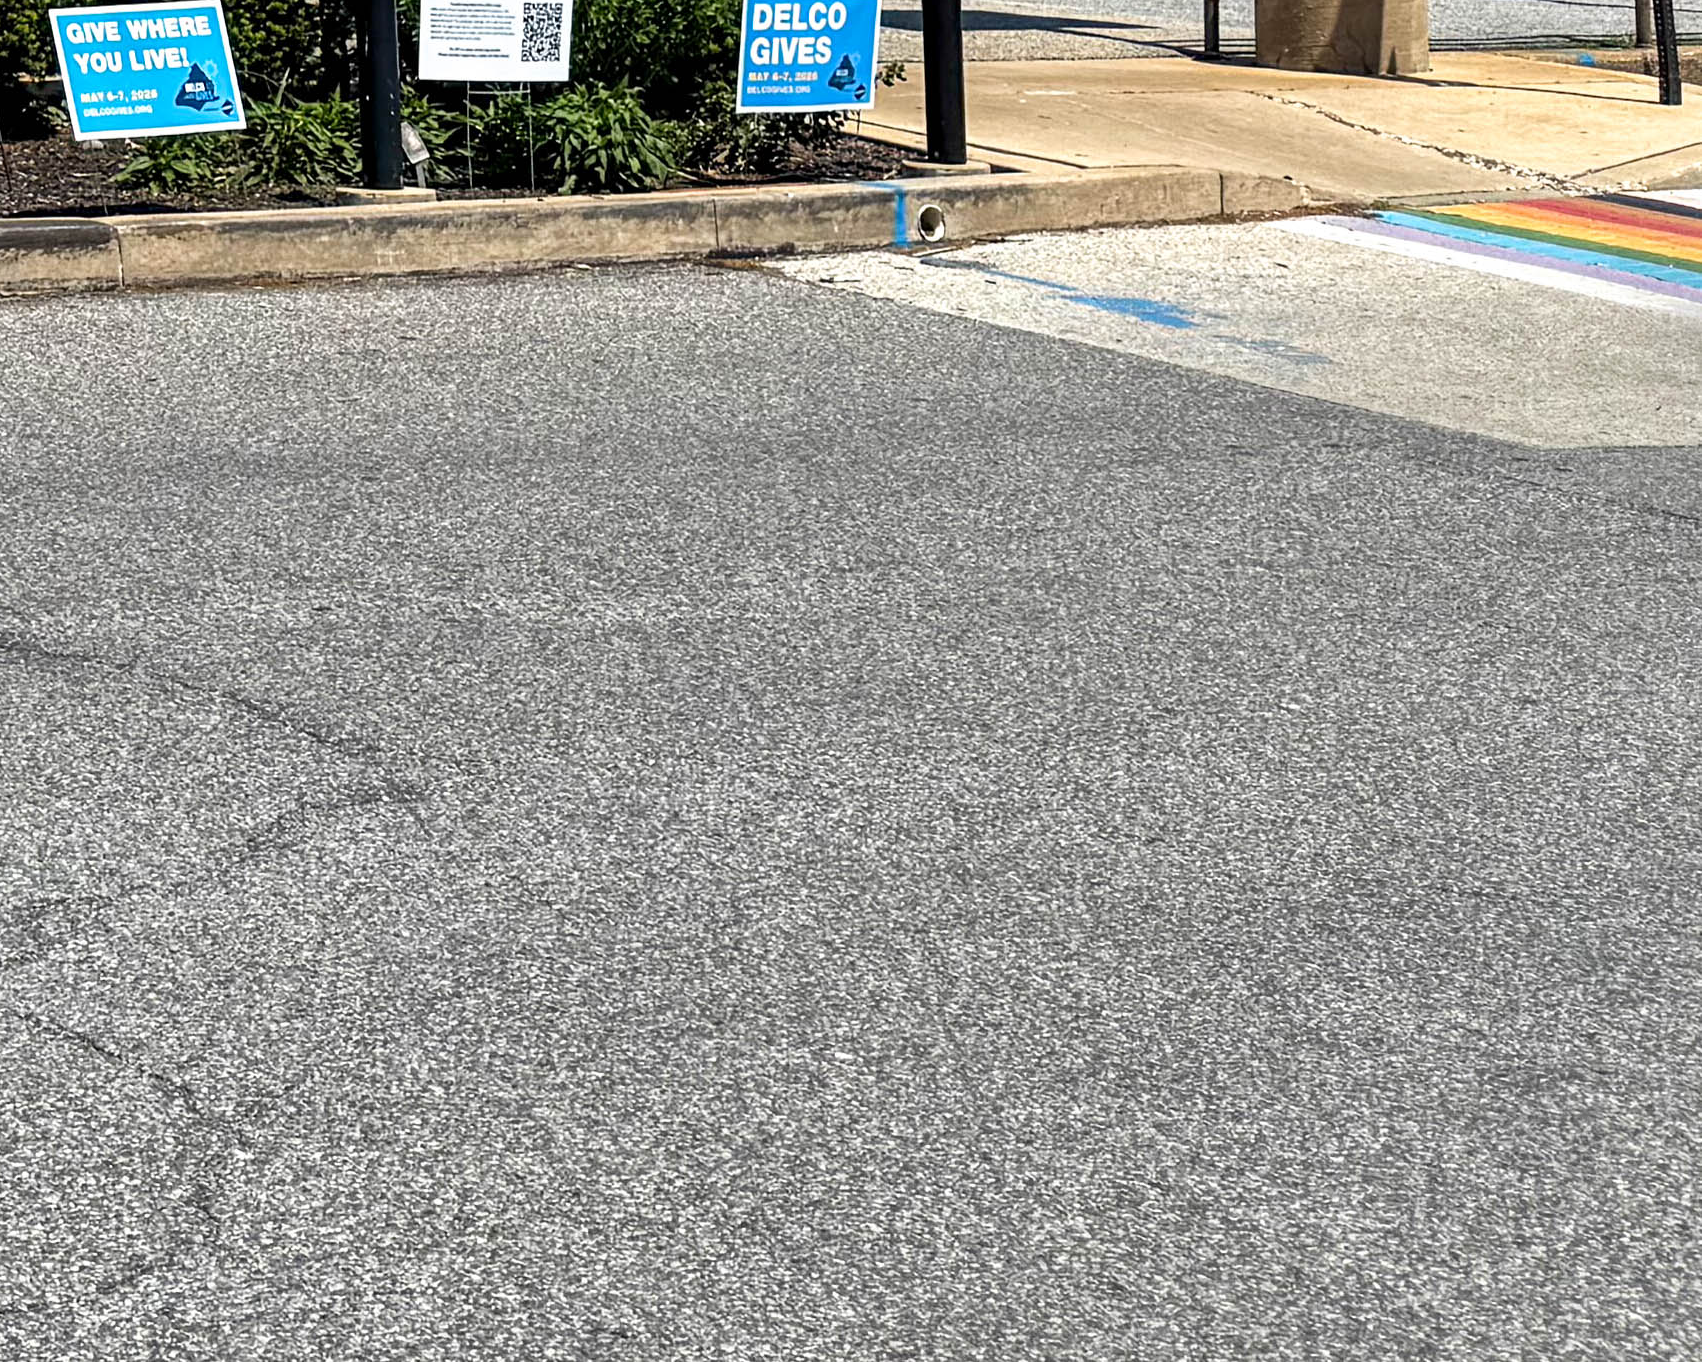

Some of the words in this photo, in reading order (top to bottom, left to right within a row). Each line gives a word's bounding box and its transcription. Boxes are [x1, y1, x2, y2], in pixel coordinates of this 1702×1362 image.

[66, 21, 122, 45] GIVE
[126, 15, 212, 41] WHERE
[752, 1, 847, 31] DELCO
[73, 51, 123, 74] YOU
[129, 47, 190, 72] LIVE!
[749, 36, 832, 65] GIVES
[748, 72, 770, 81] MAY
[80, 91, 106, 104] MAY
